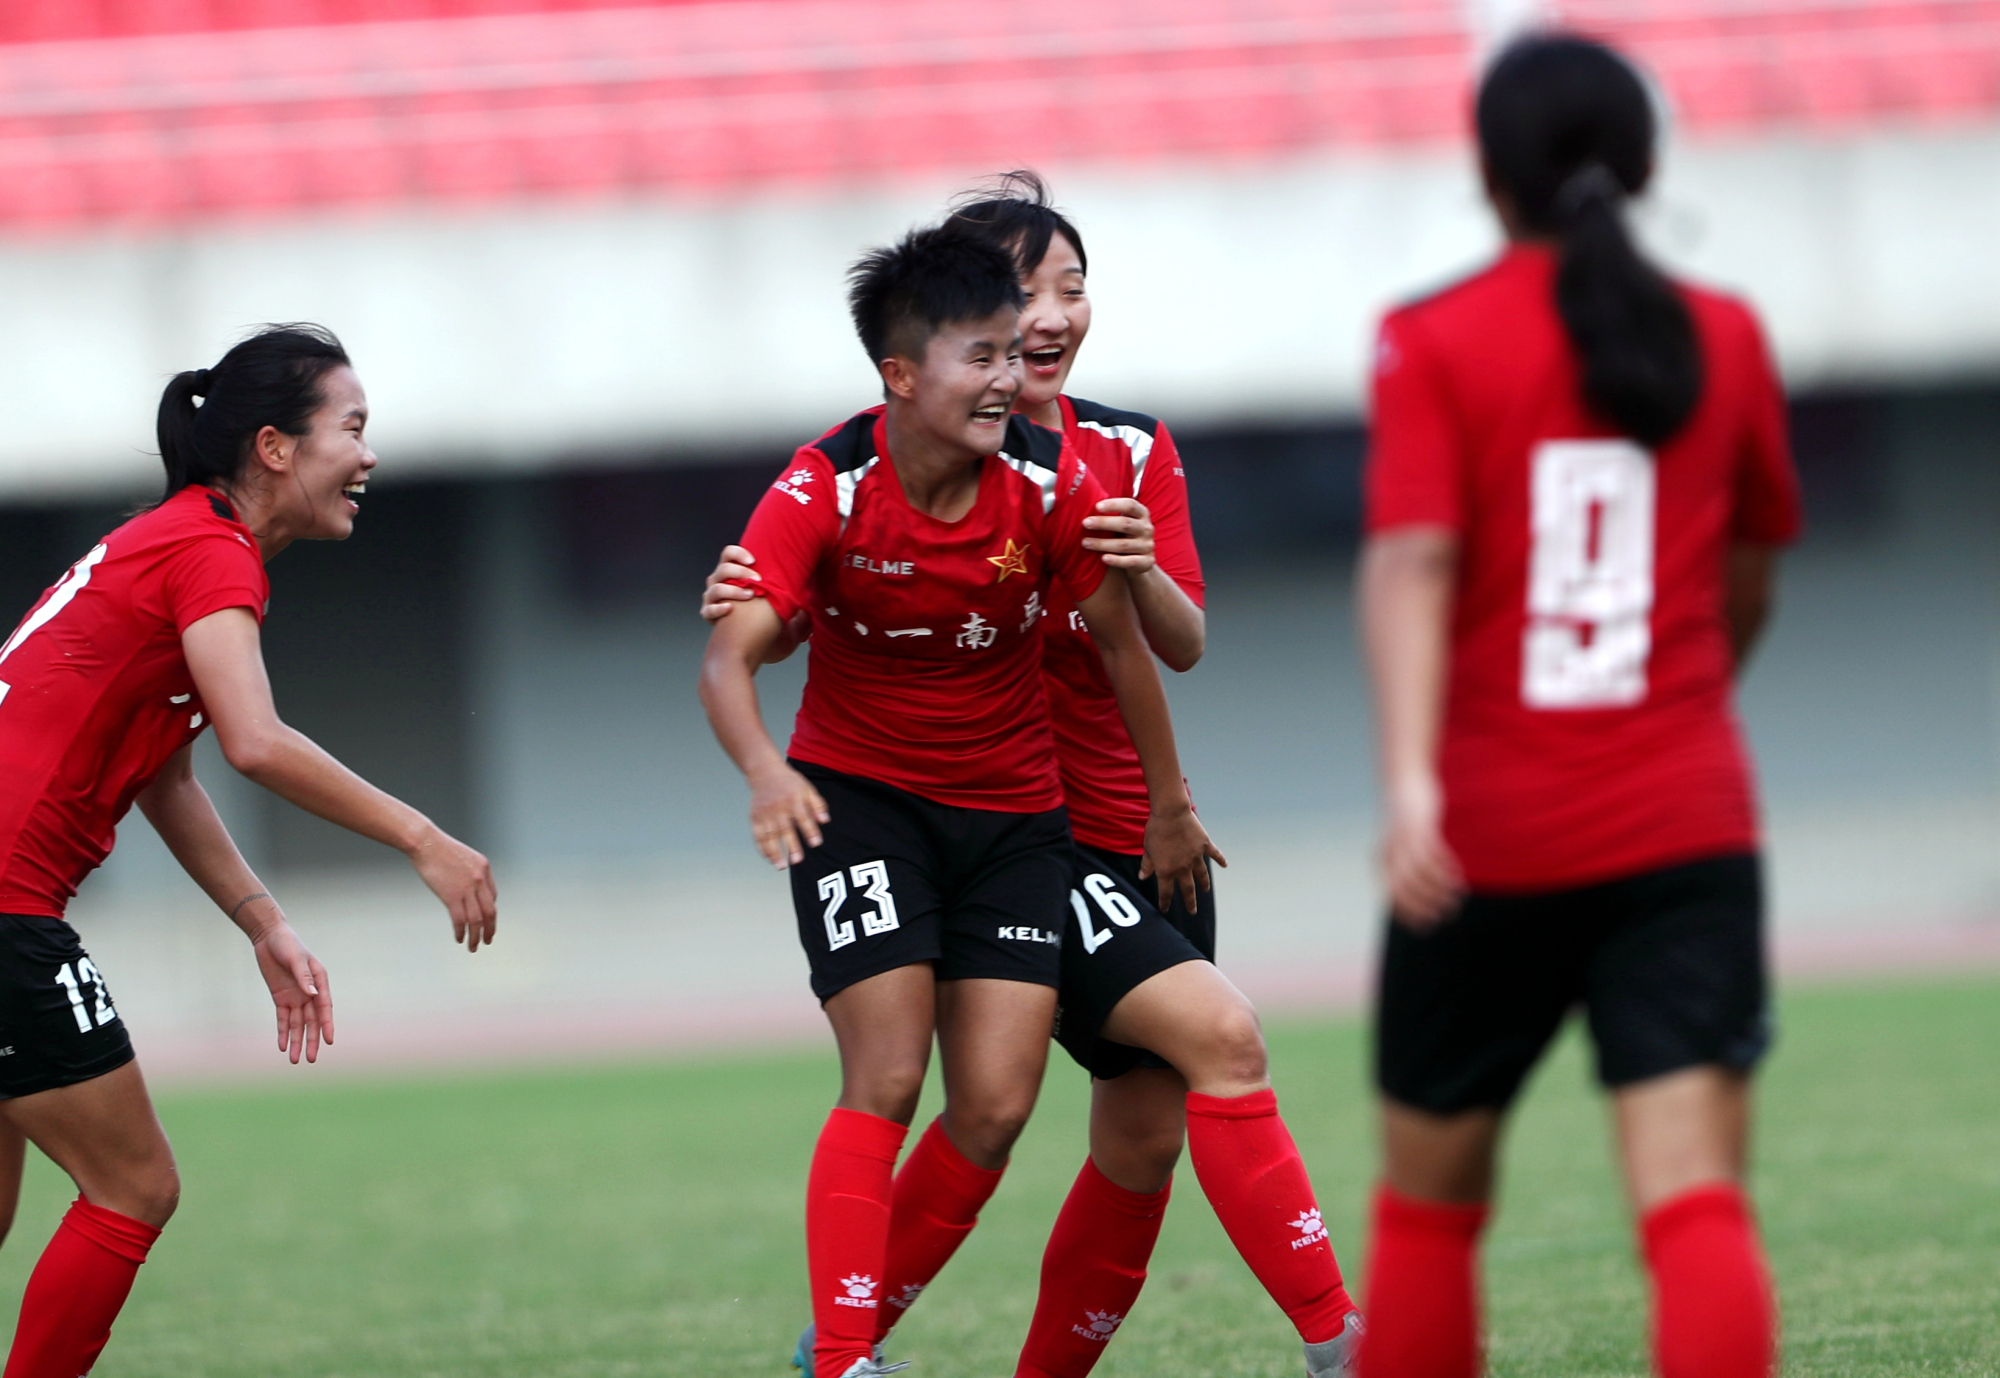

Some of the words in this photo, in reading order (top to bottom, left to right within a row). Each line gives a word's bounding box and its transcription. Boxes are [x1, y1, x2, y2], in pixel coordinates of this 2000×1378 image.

[1522, 437, 1656, 709] 9
[817, 860, 900, 951] 23
[998, 926, 1062, 949] KELM
[1070, 873, 1142, 954] 26
[55, 957, 116, 1033] 12
